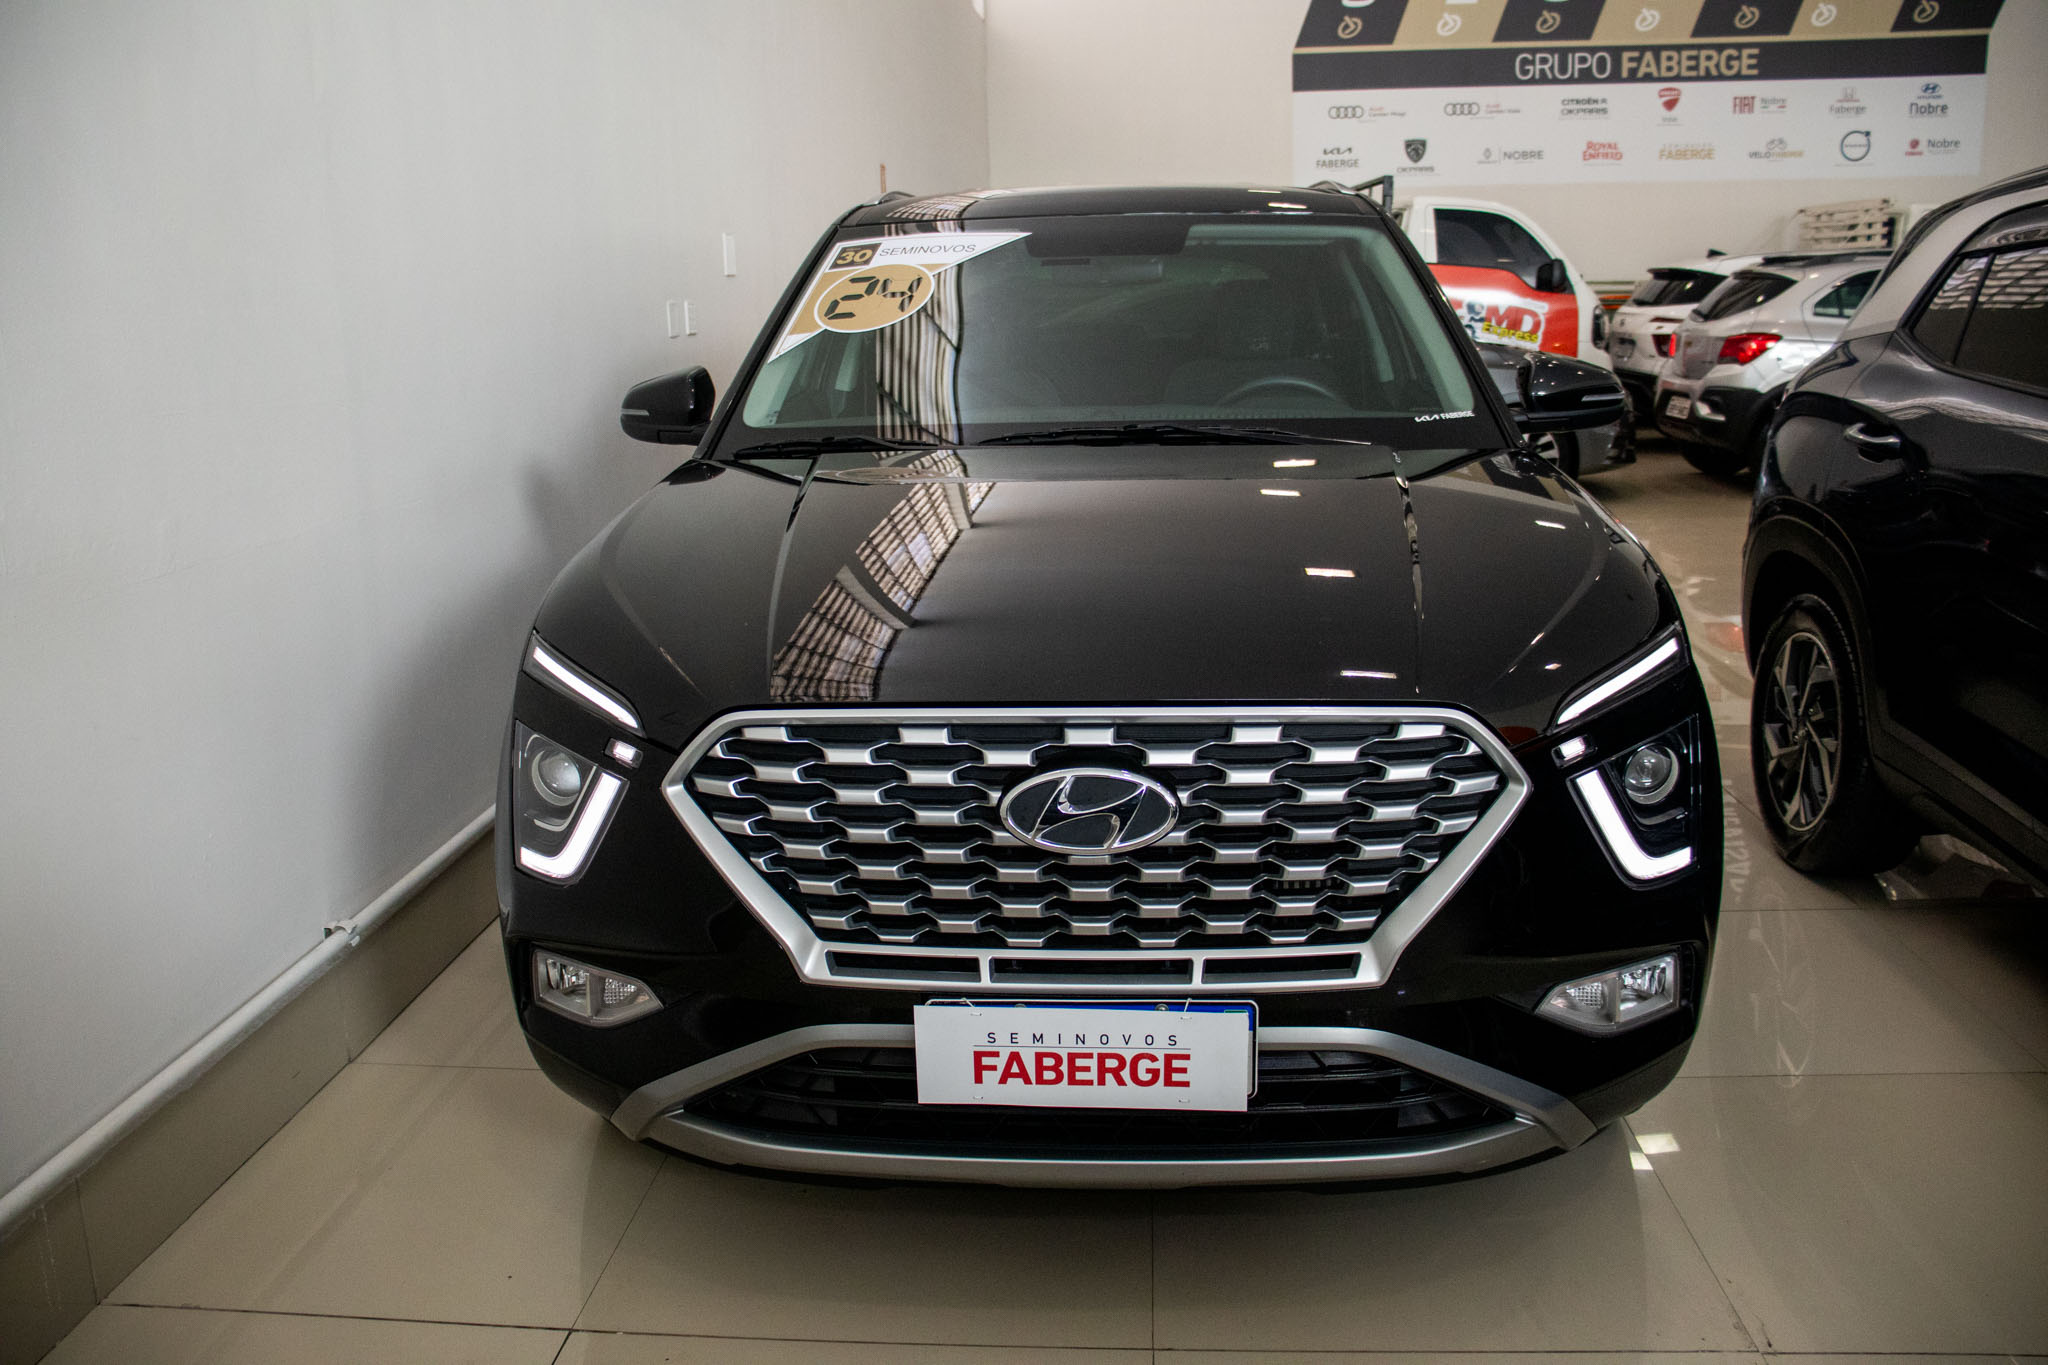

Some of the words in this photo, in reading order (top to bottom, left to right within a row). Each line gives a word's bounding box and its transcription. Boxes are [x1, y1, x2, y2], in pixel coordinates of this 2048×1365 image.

[1515, 52, 1611, 81] GRUPO
[1621, 48, 1760, 79] FABERGE
[1733, 96, 1756, 114] FIAT
[1829, 104, 1867, 115] Faberge
[1587, 141, 1618, 151] ROYAL
[1928, 139, 1961, 149] Nobre
[1503, 150, 1544, 160] NOBRE
[1581, 150, 1624, 161] ENFIELD
[1658, 148, 1716, 160] FABERGE
[1316, 158, 1360, 169] FABERGE
[836, 248, 874, 265] 30
[878, 243, 977, 257] SEMINOVOS
[823, 274, 923, 321] 24
[1481, 321, 1539, 344] Express
[987, 1032, 1178, 1047] SEMINOVOS
[972, 1050, 1191, 1088] FABERGE
